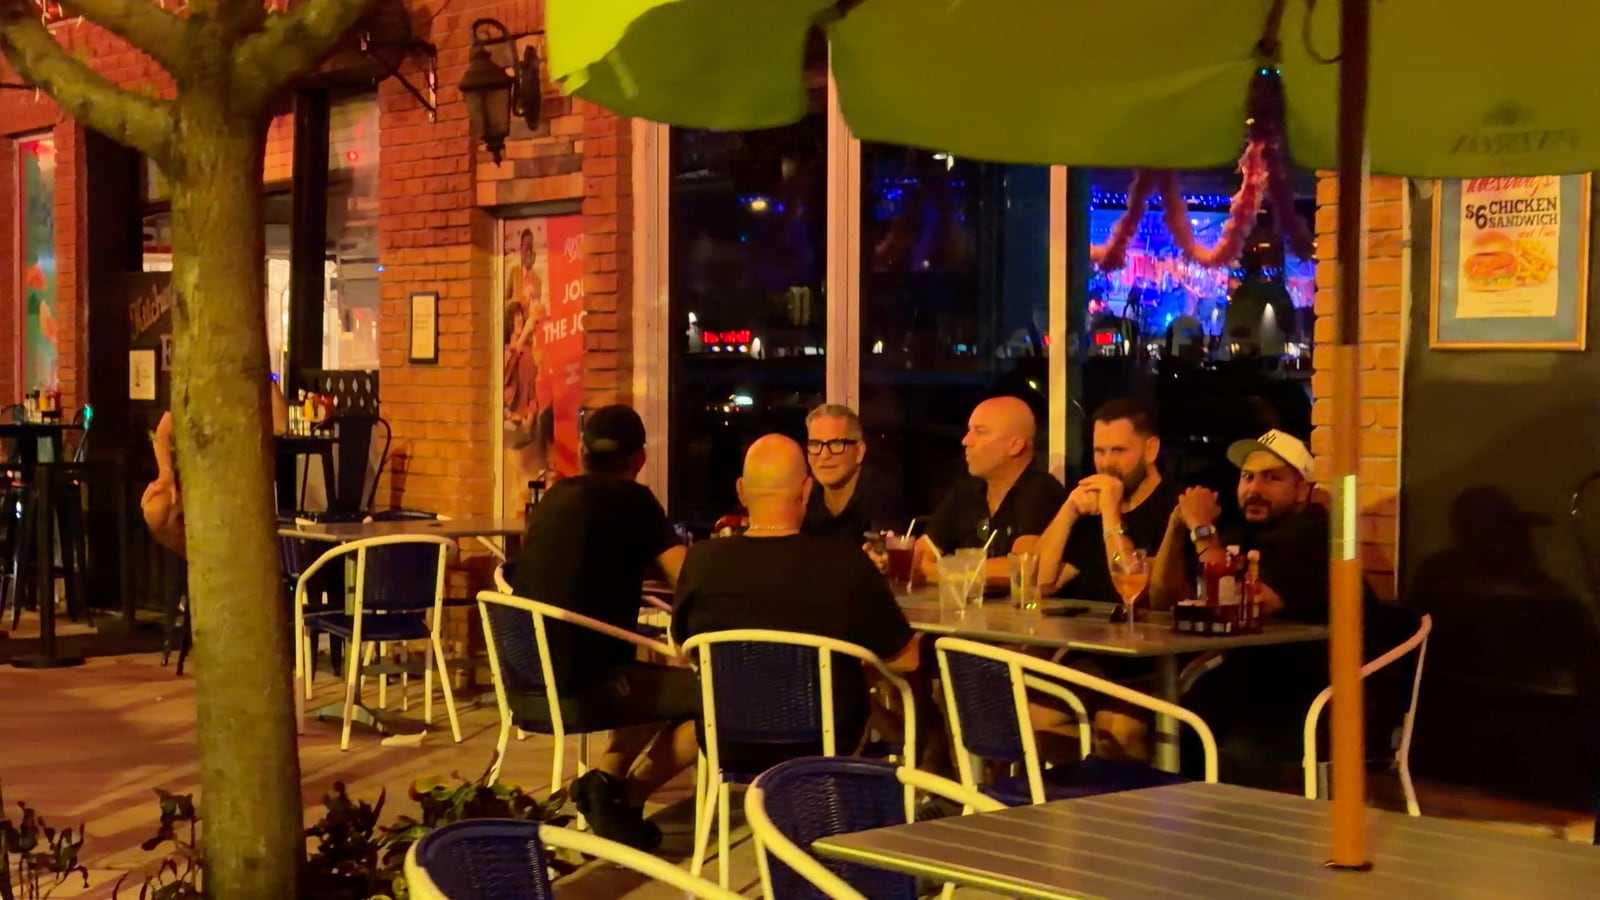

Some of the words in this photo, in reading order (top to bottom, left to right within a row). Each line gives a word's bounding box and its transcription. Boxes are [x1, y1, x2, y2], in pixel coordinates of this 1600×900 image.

[1465, 203, 1488, 230] $6
[1489, 196, 1558, 215] CHICKEN
[1488, 213, 1558, 229] SANDWICH
[543, 317, 568, 344] THE
